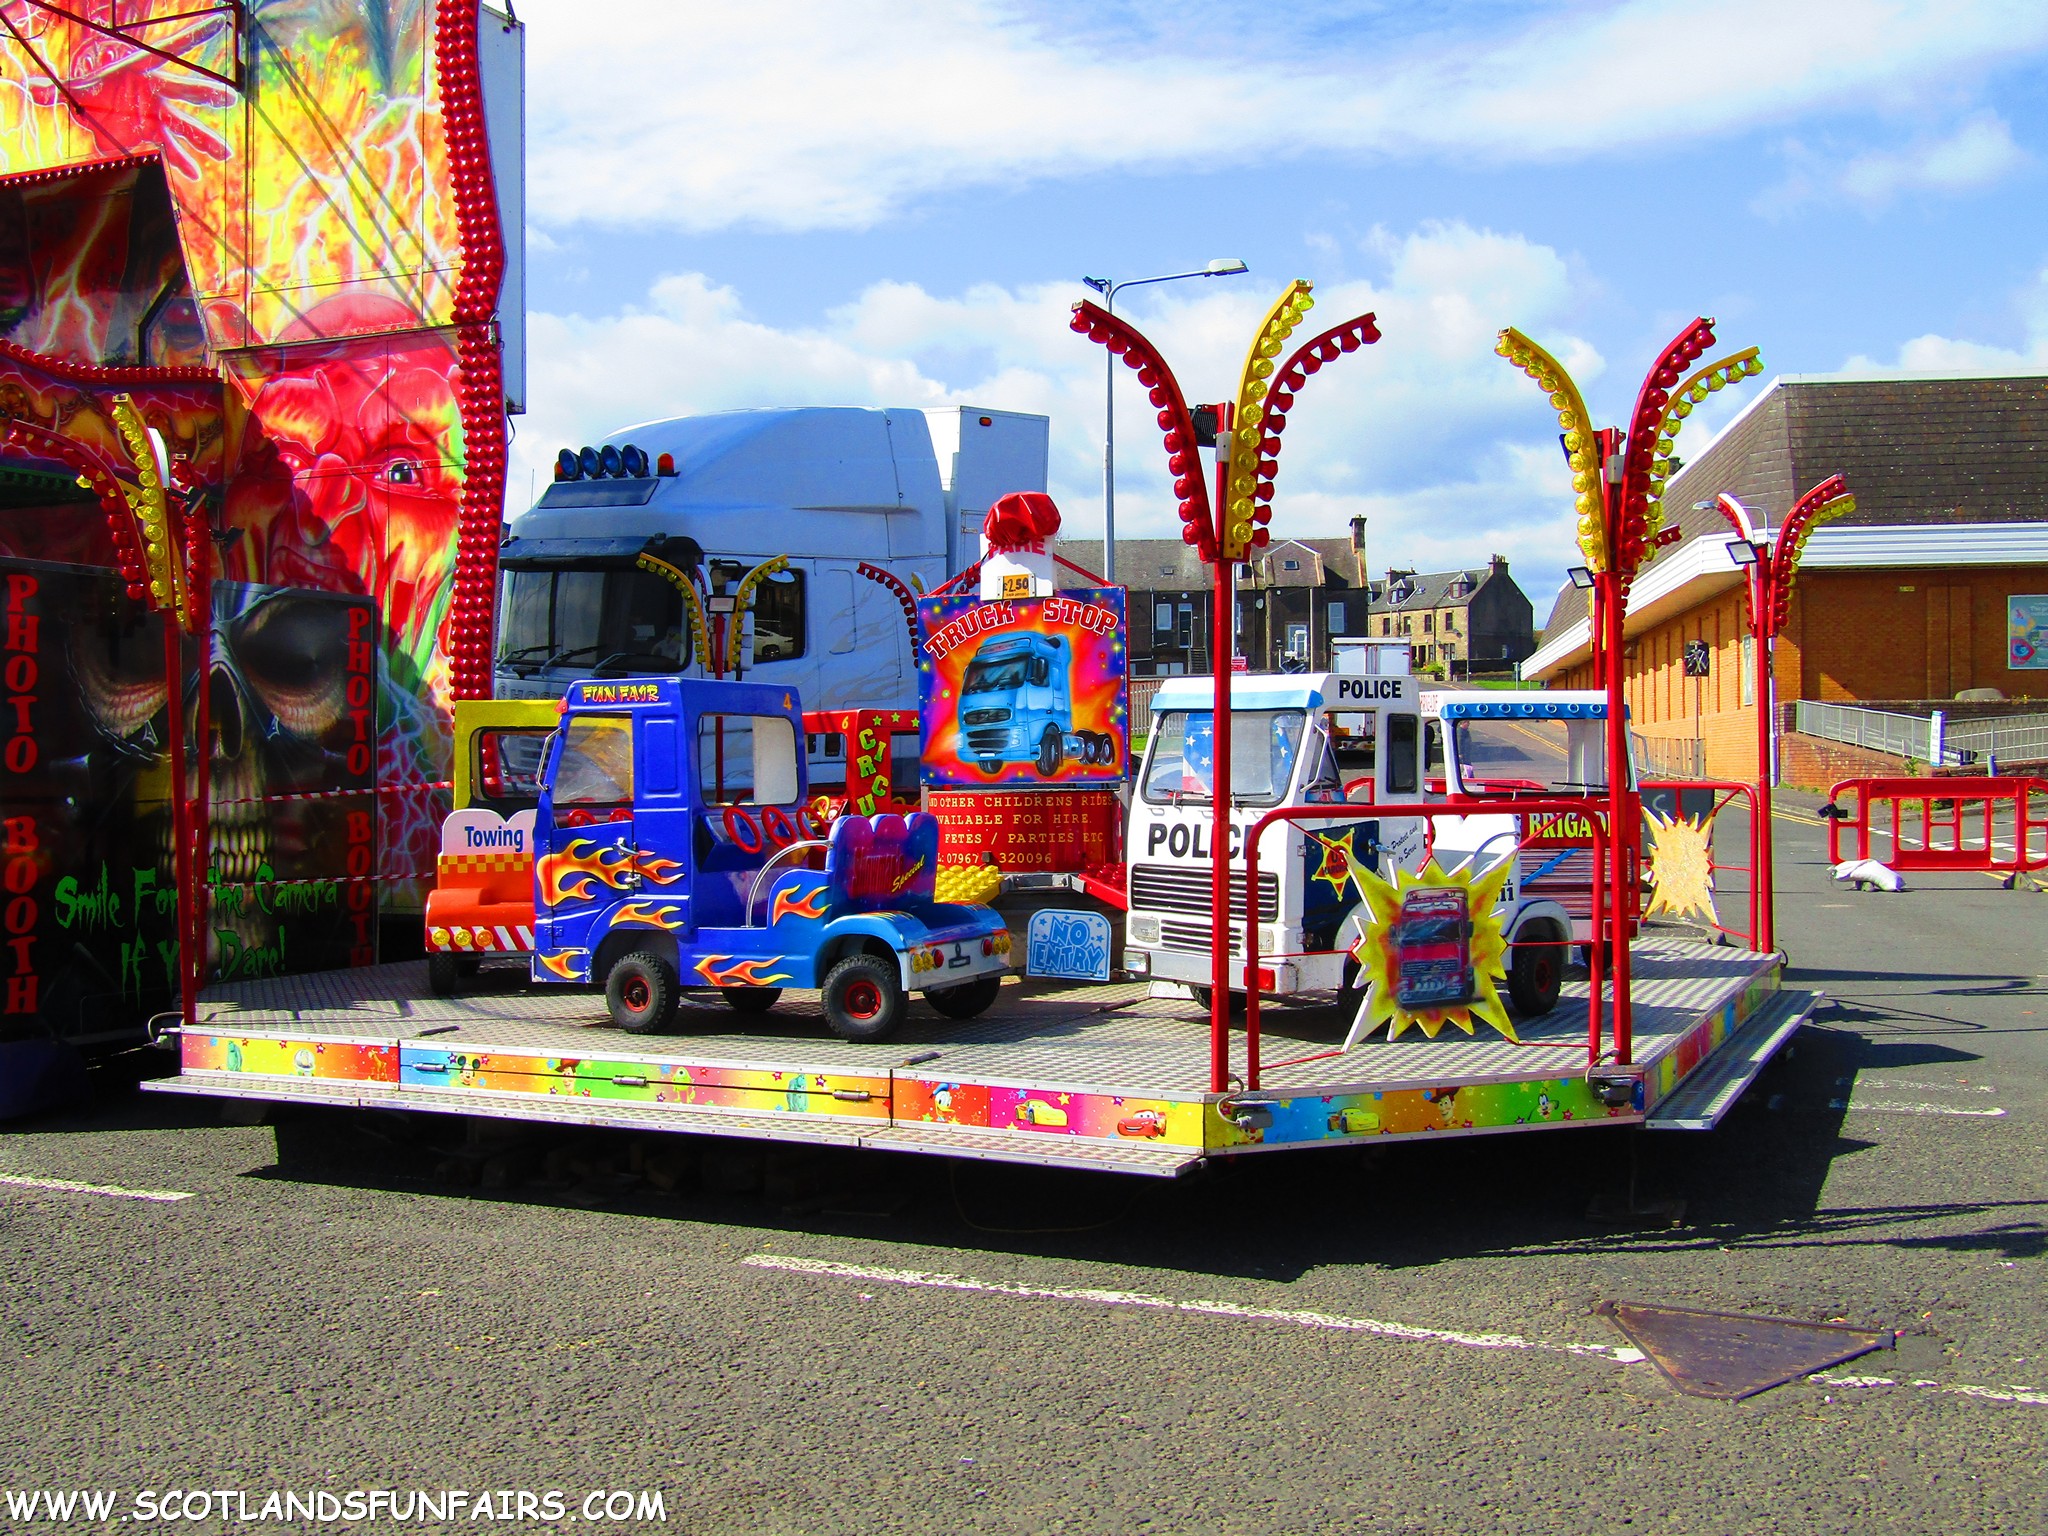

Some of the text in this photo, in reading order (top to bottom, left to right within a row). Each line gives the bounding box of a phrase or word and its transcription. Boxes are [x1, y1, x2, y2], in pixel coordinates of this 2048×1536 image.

[923, 597, 1118, 660] TRUCK STOP
[583, 684, 660, 702] FUN FAIR
[783, 693, 792, 710] 4
[1339, 680, 1401, 699] POLICE
[842, 716, 849, 730] 6
[857, 728, 889, 817] CIRCU
[3, 574, 39, 1014] PHOTO BOOTH
[346, 607, 373, 967] PHOTO BOOTH
[940, 797, 975, 807] OTHER
[984, 796, 1073, 807] CHILDRENS
[1082, 795, 1113, 806] RIDES
[936, 814, 1003, 825] VAILABLE
[1013, 814, 1043, 824] FOR
[464, 825, 523, 853] Towing
[945, 832, 1104, 845] FETES / PARTIES ETC
[946, 852, 979, 864] 07967
[999, 852, 1052, 864] 320096
[891, 854, 925, 893] Special
[54, 860, 126, 934] Smile
[255, 862, 338, 918] Camera
[1496, 887, 1514, 902] 11
[1050, 916, 1090, 947] NO
[213, 924, 287, 983] Dare!
[1033, 941, 1105, 974] ENTRY
